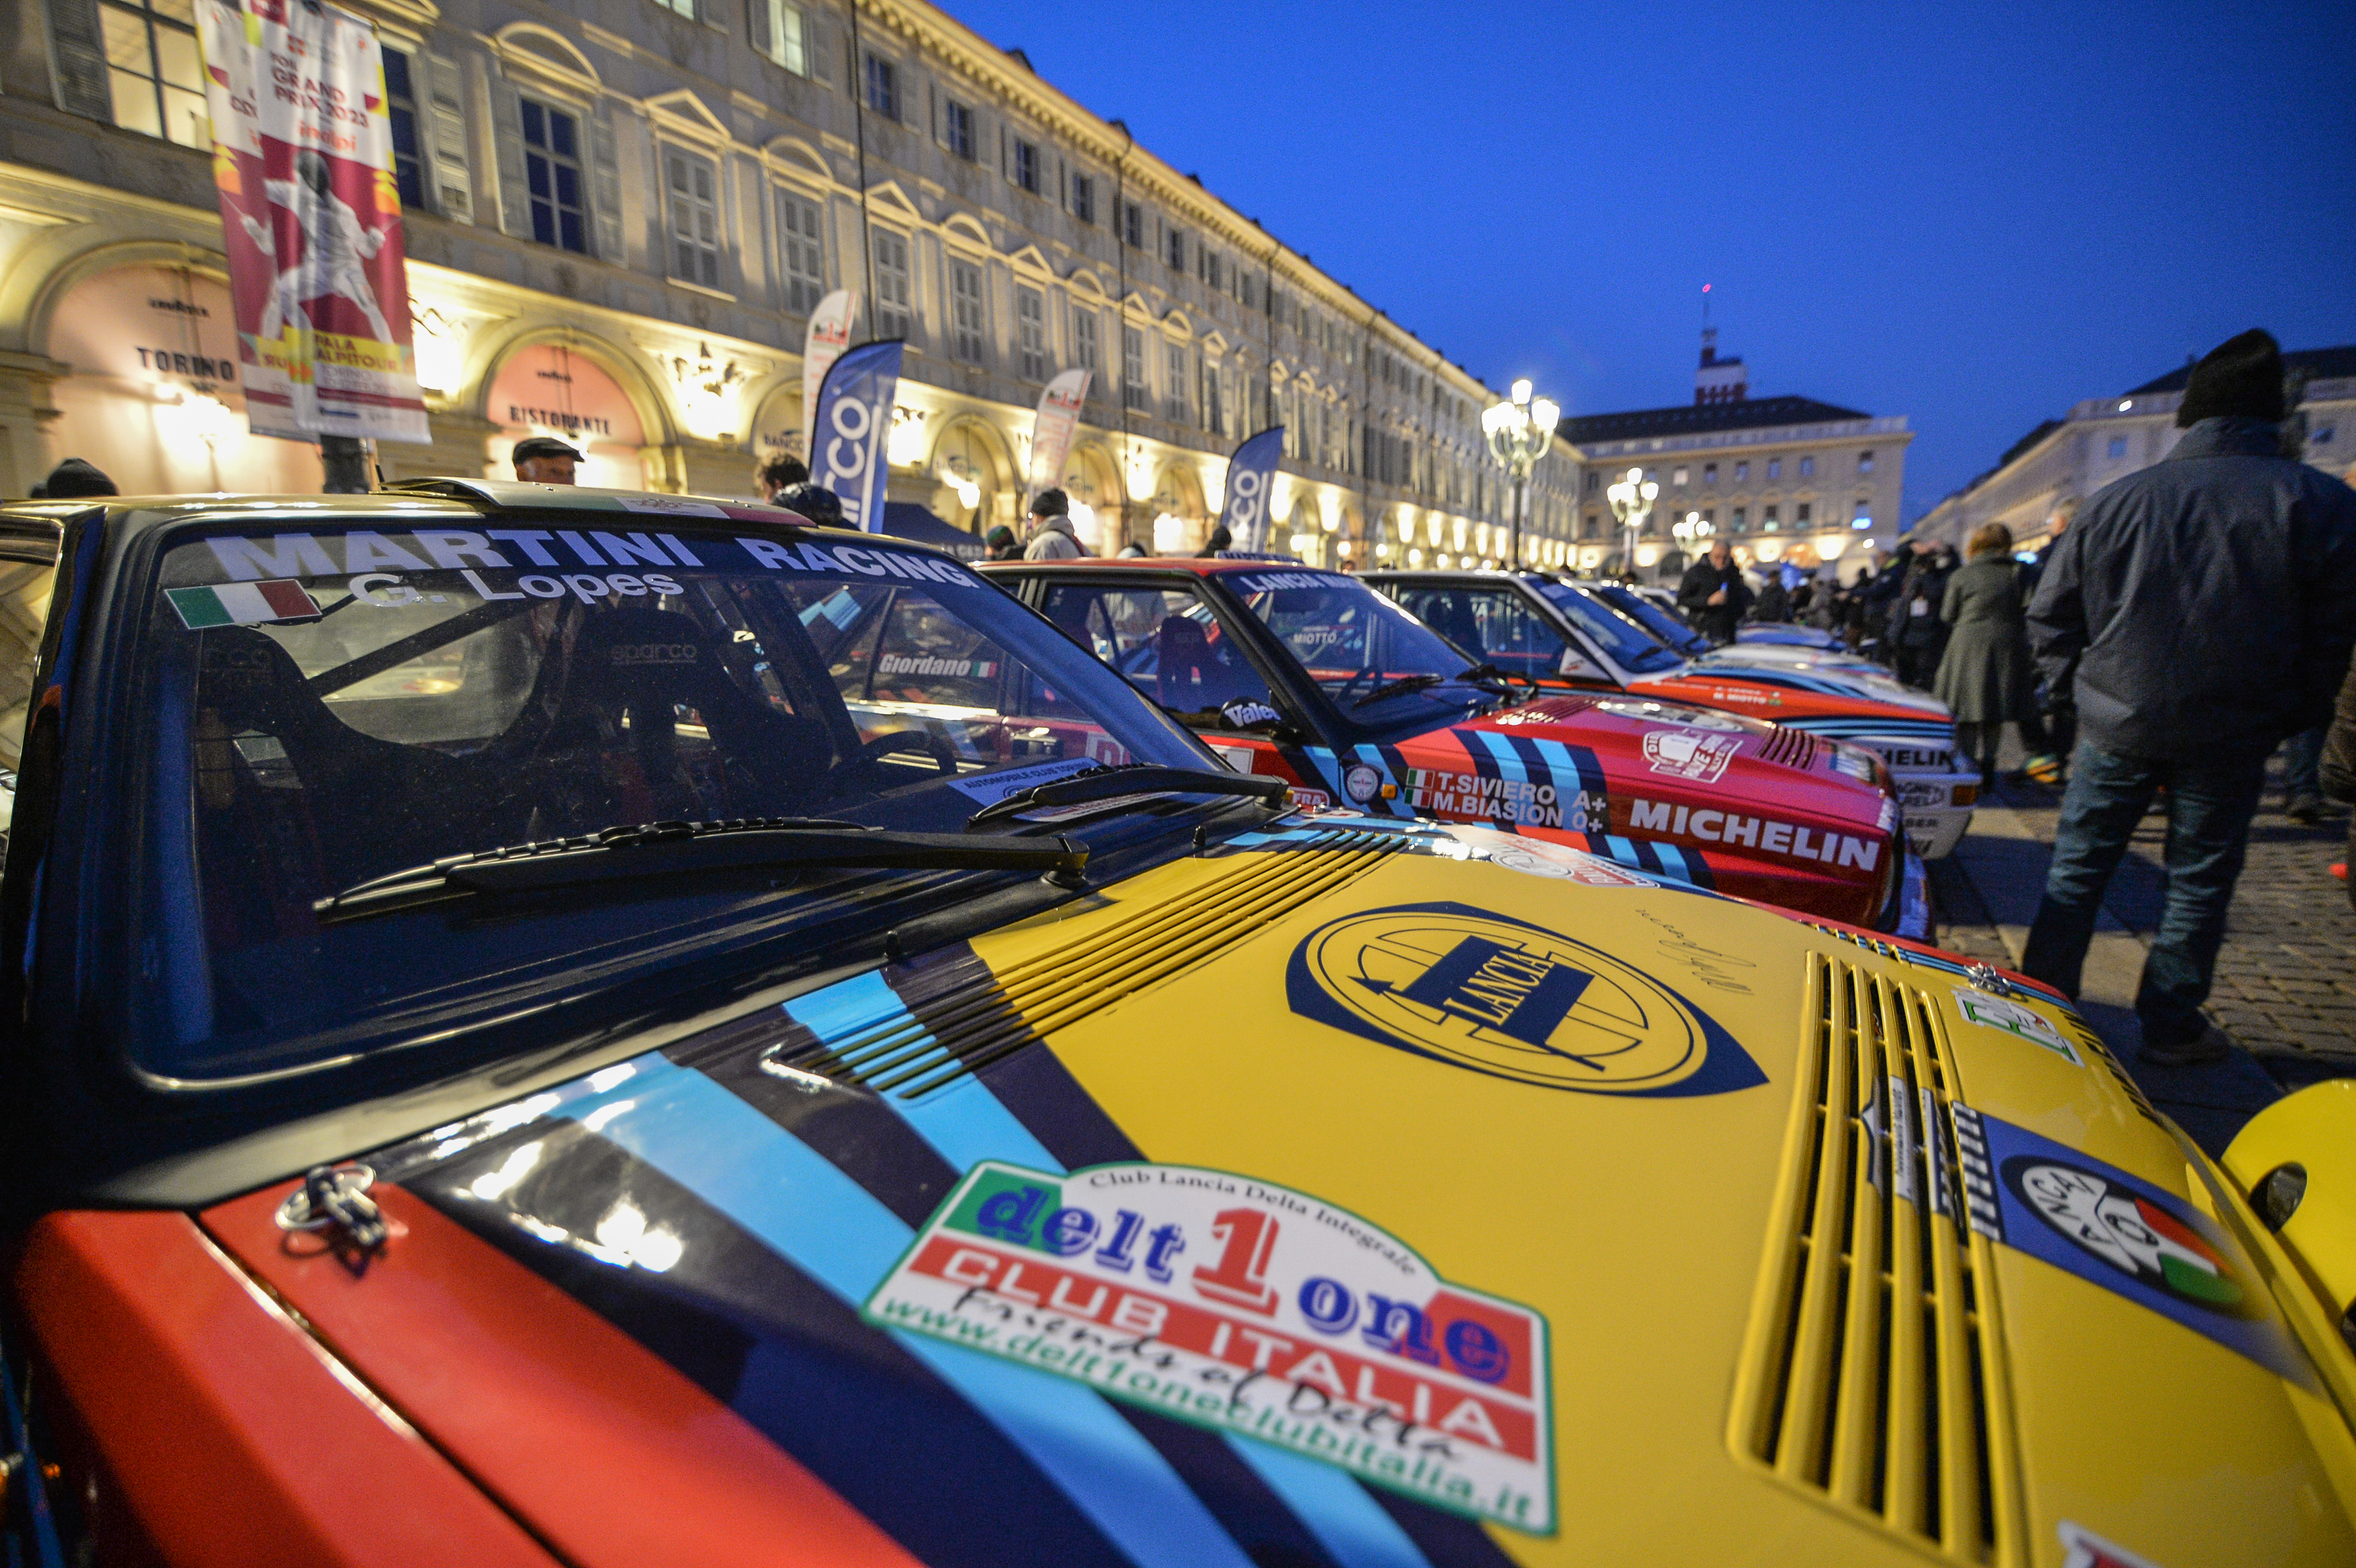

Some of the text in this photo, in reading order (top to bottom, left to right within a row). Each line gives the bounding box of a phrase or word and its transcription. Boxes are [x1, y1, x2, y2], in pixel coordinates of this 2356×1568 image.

[272, 65, 346, 102] GRAND
[273, 83, 323, 112] PRIX
[136, 347, 235, 382] TORINO
[316, 348, 398, 371] ALPITOUR
[510, 405, 611, 435] RISTORANTE
[204, 529, 979, 588] MARTINI RACING
[347, 569, 685, 608] G. Lopes
[1239, 572, 1325, 593] LANCIA
[611, 643, 697, 662] sparco
[1292, 632, 1338, 645] MIOTTO
[878, 653, 971, 678] Giordano
[964, 769, 1030, 789] AUTOMOBILE
[1030, 767, 1057, 779] CLUB
[1437, 773, 1607, 813] T.SIVIERO A+
[1432, 791, 1564, 828] M.BIASION
[1630, 798, 1881, 872] MICHELIN
[1443, 950, 1555, 1026] LANCIA
[1089, 1170, 1417, 1277] Club Lancia Delta Integrale
[942, 1248, 1505, 1450] CLUB ITALIA
[882, 1295, 1532, 1521] www.delt1oneclubitalia.it
